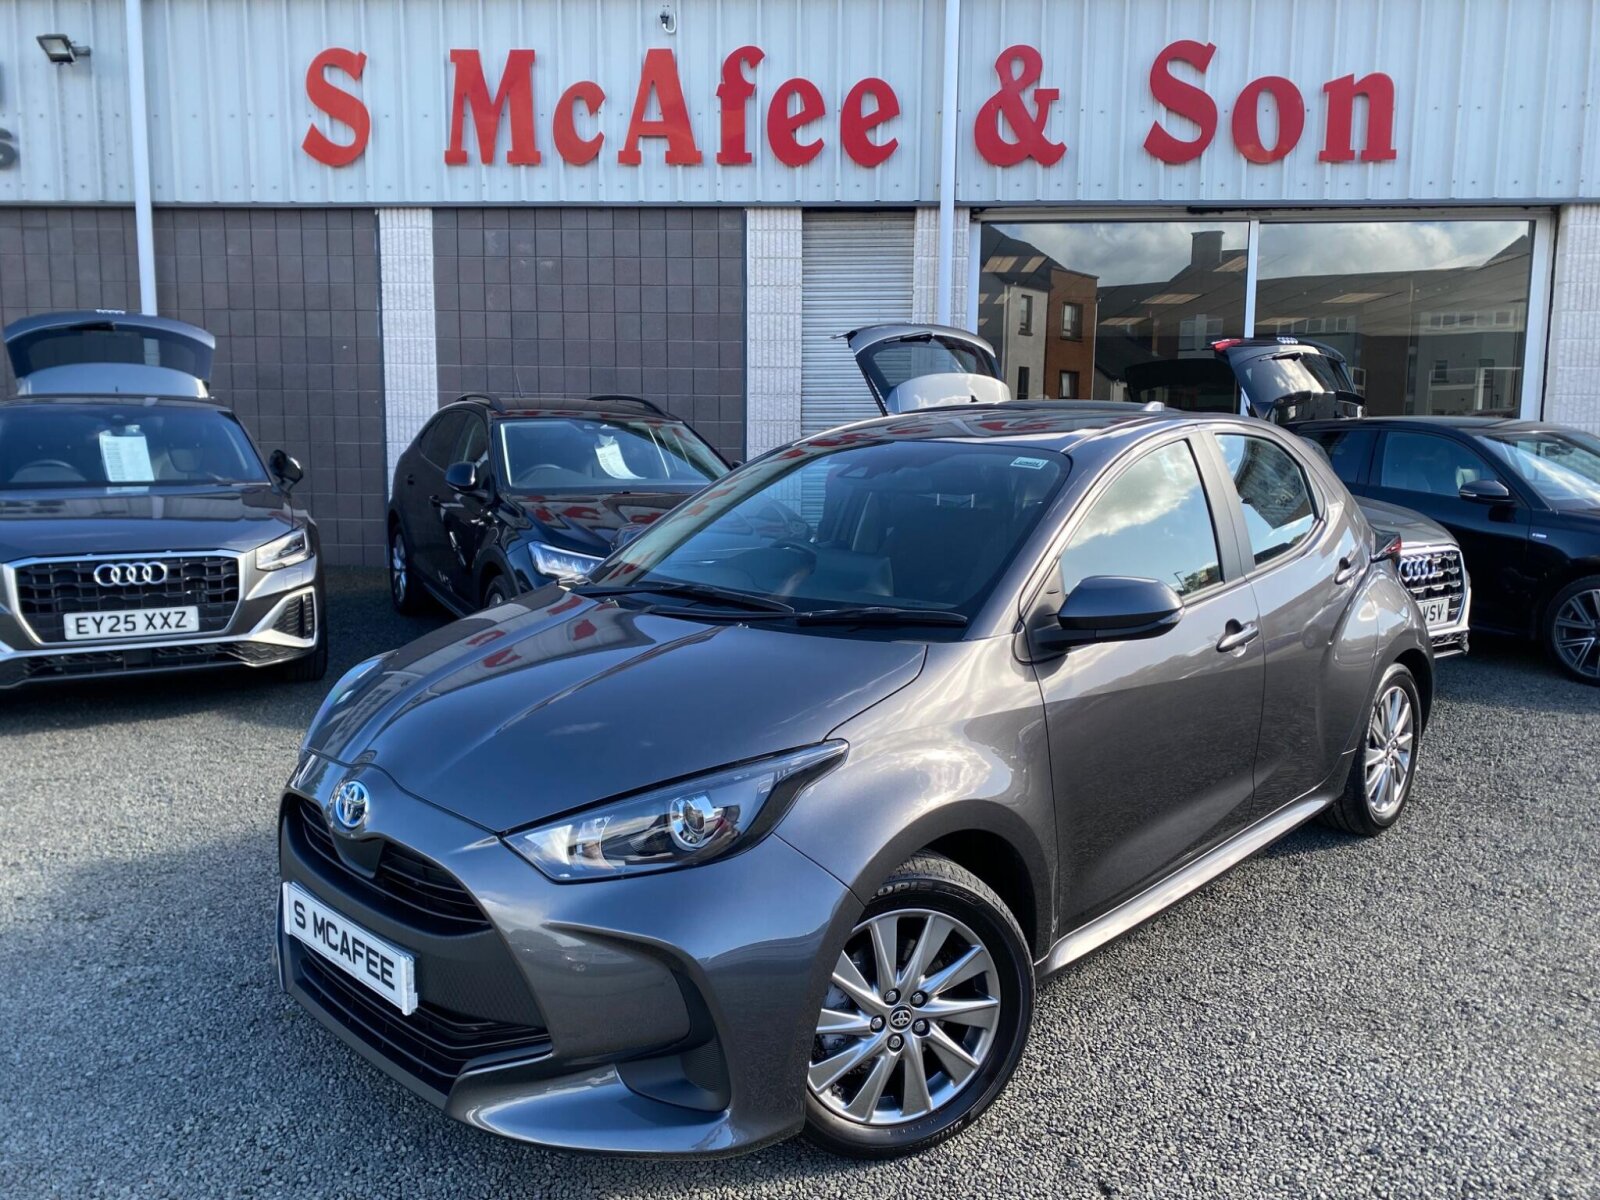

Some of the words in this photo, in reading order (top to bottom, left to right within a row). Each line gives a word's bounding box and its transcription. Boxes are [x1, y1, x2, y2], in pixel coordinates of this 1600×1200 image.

[302, 48, 370, 166] S
[445, 45, 900, 167] McAfee
[974, 44, 1066, 167] &
[1144, 40, 1396, 164] Son
[75, 614, 137, 635] EY25
[144, 611, 188, 631] XXZ
[294, 900, 307, 930] S
[313, 910, 396, 992] MCAFEE
